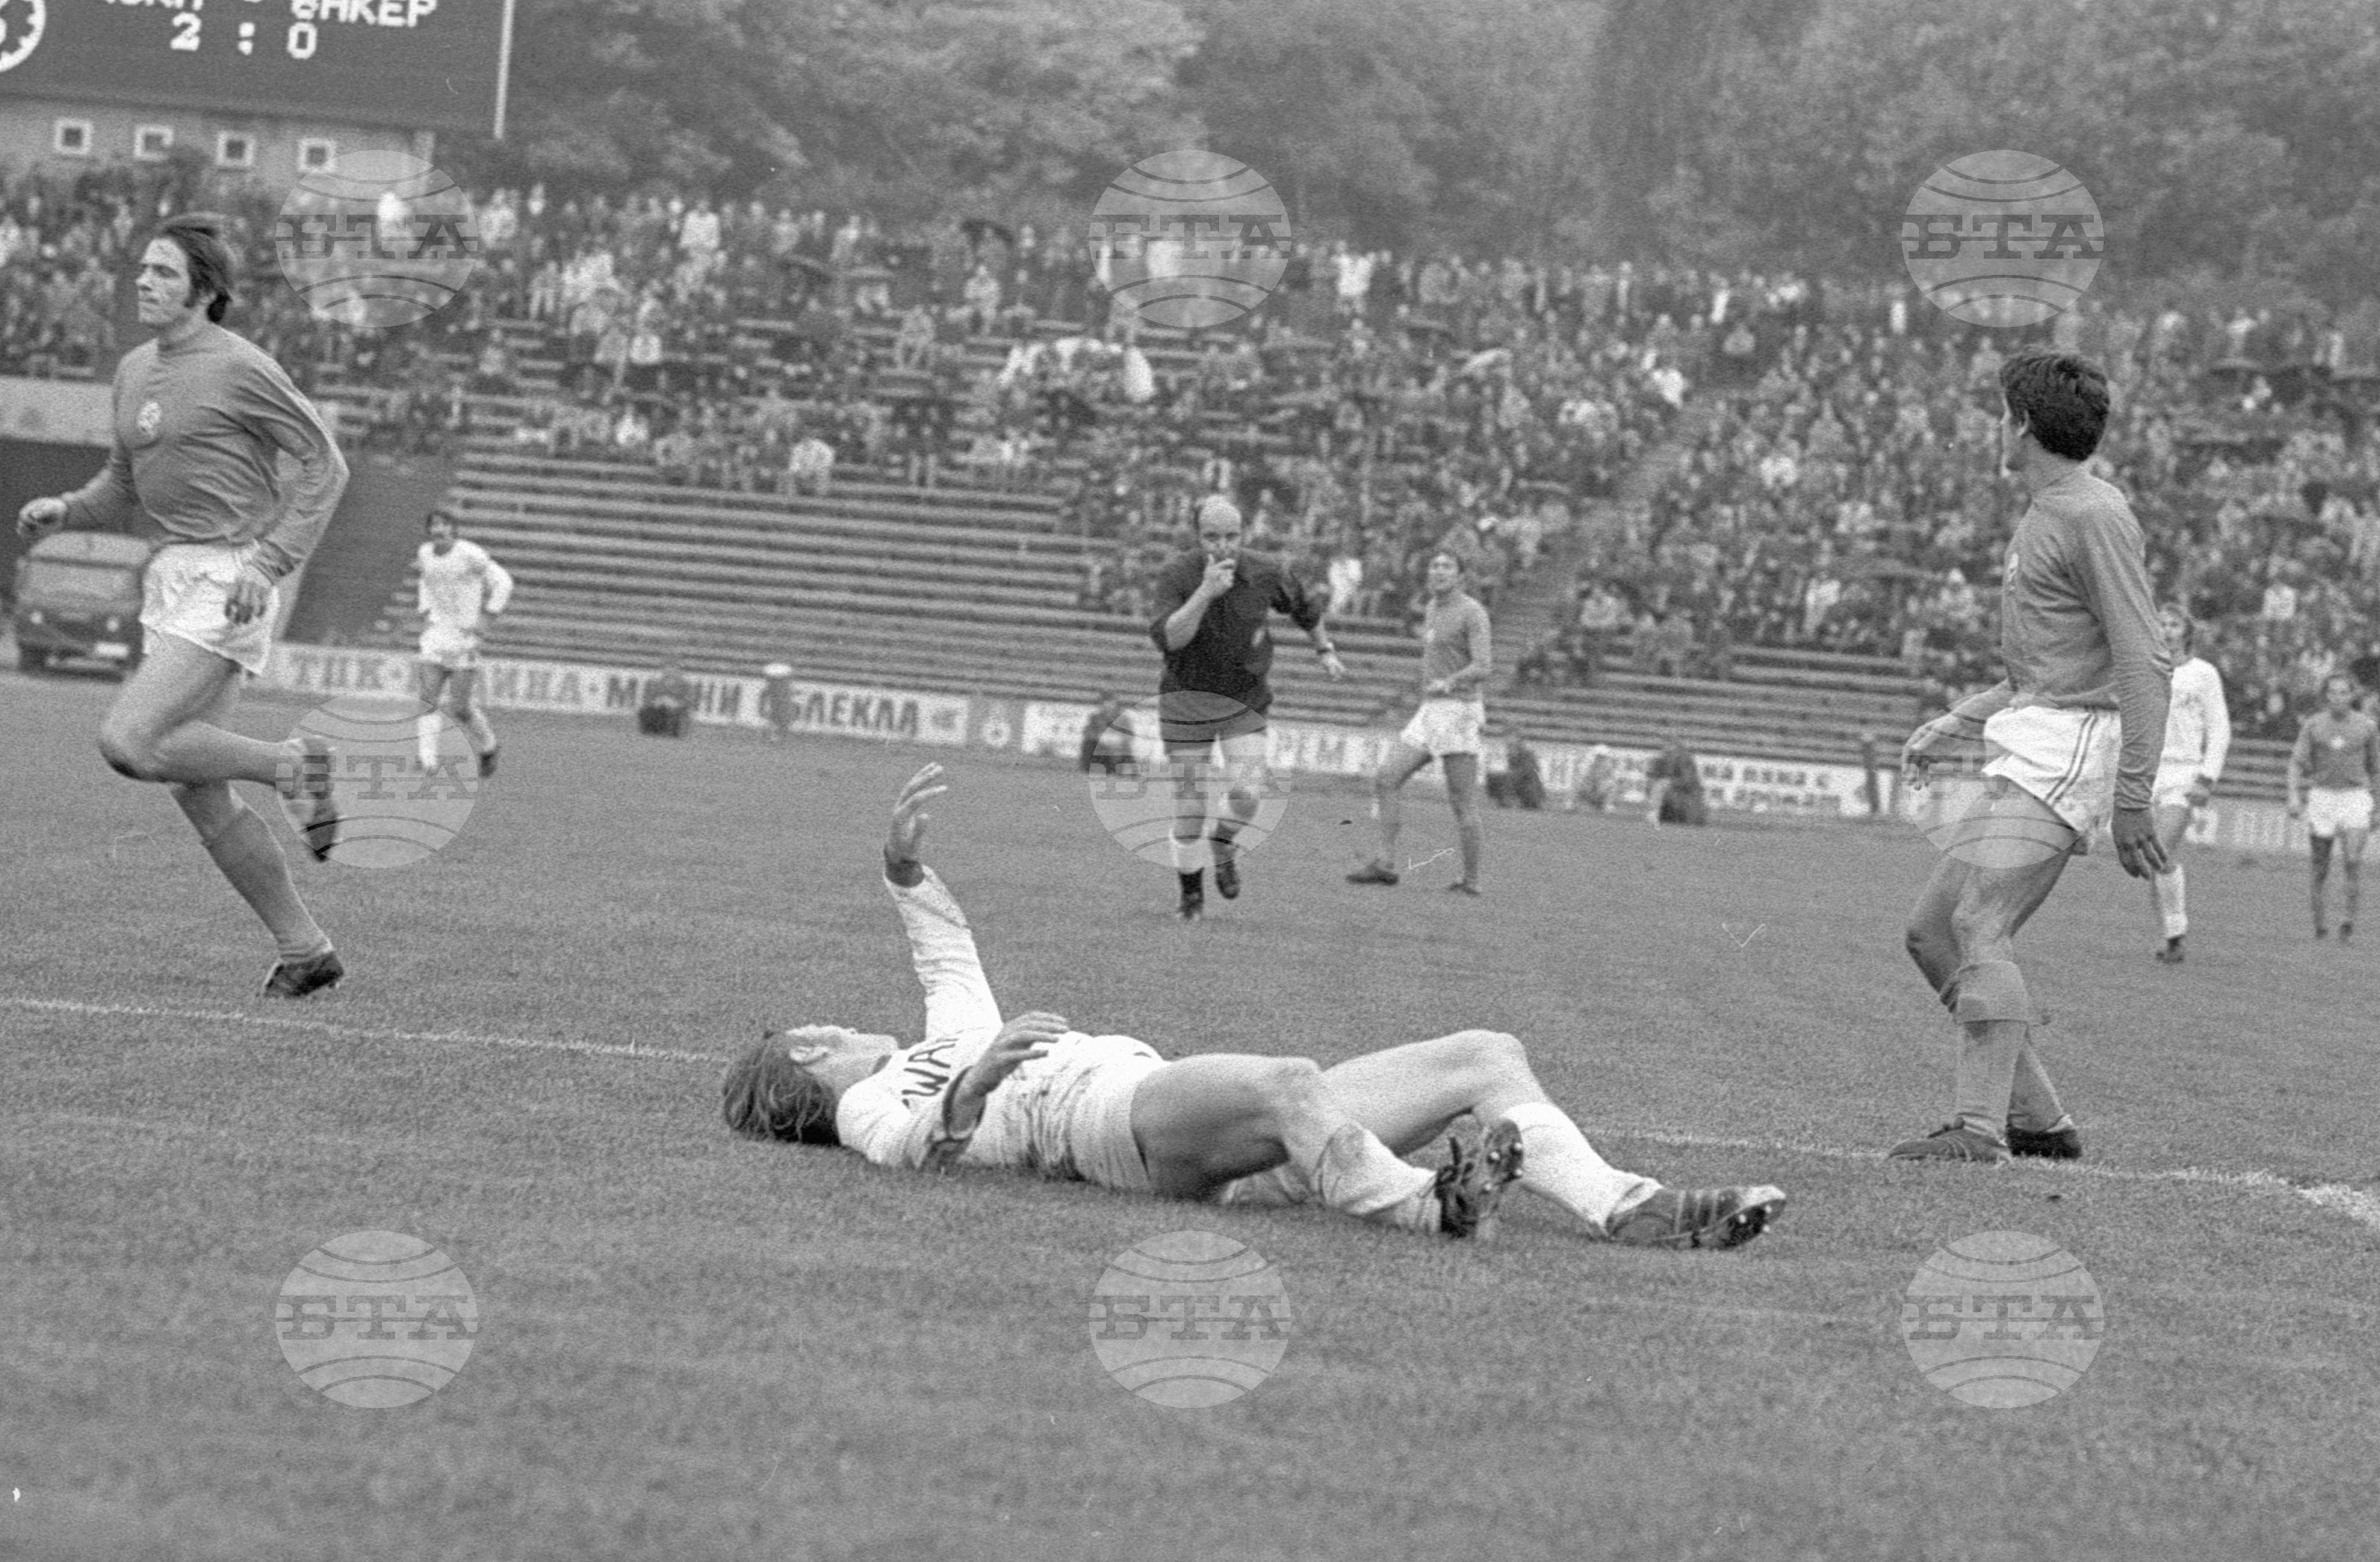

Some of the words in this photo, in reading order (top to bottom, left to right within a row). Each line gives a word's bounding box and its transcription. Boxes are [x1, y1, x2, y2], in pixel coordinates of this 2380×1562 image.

[170, 12, 201, 51] 2
[287, 22, 317, 59] 0
[606, 676, 743, 716] МНИ
